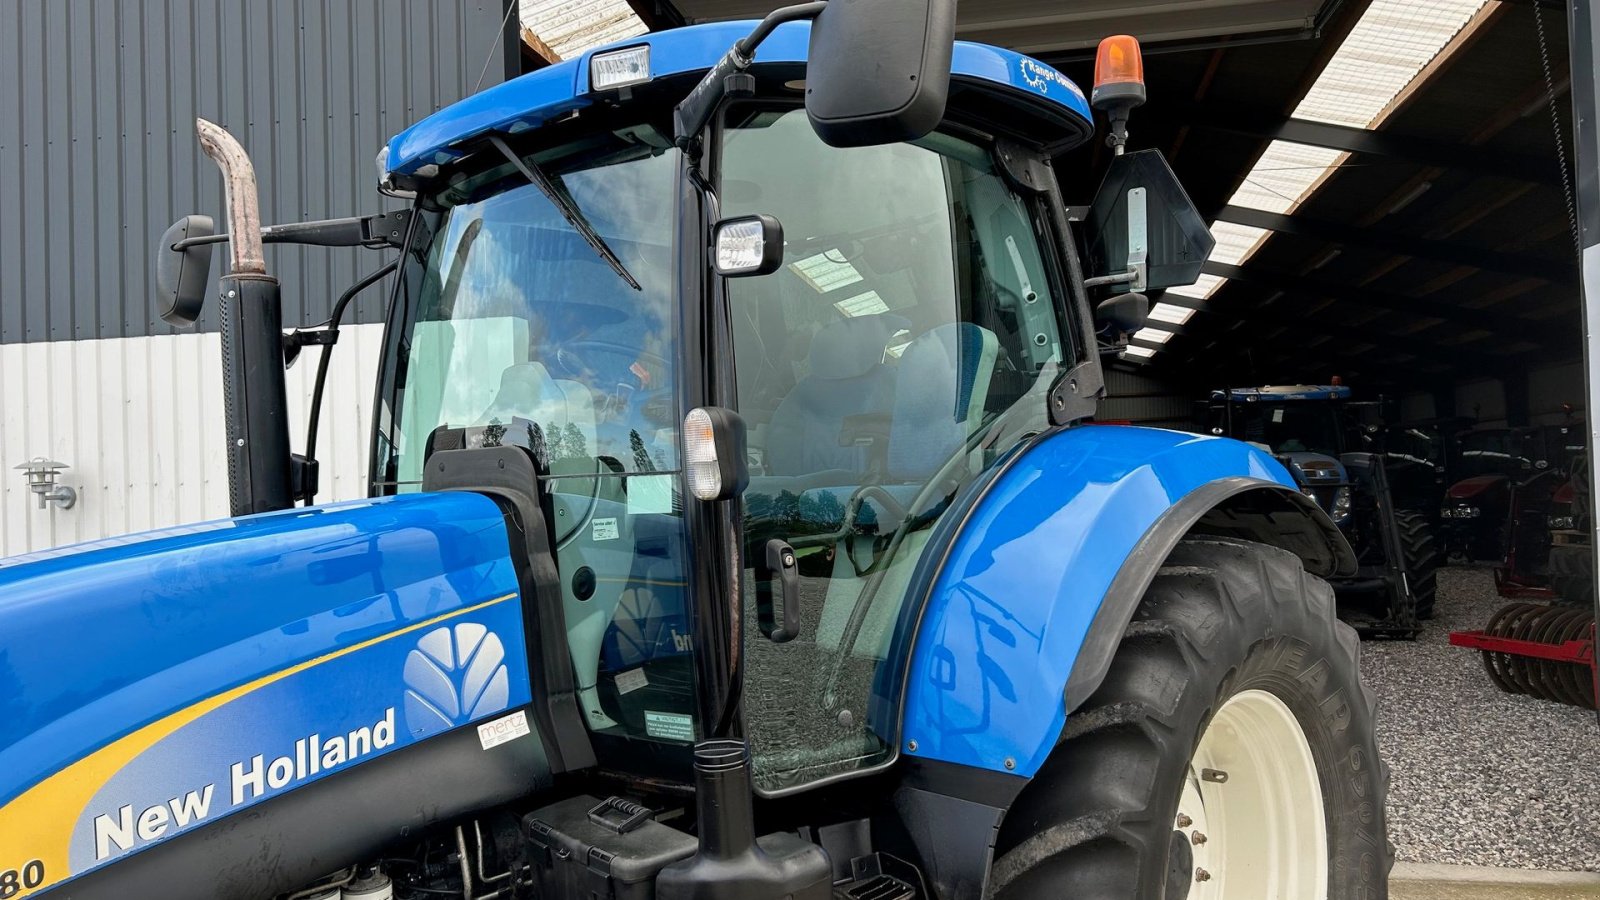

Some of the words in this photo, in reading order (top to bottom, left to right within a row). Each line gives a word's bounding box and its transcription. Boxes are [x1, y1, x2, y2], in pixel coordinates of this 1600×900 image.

[481, 715, 524, 739] mertz
[94, 784, 214, 860] New
[230, 708, 395, 805] Holland
[0, 860, 45, 899] 80
